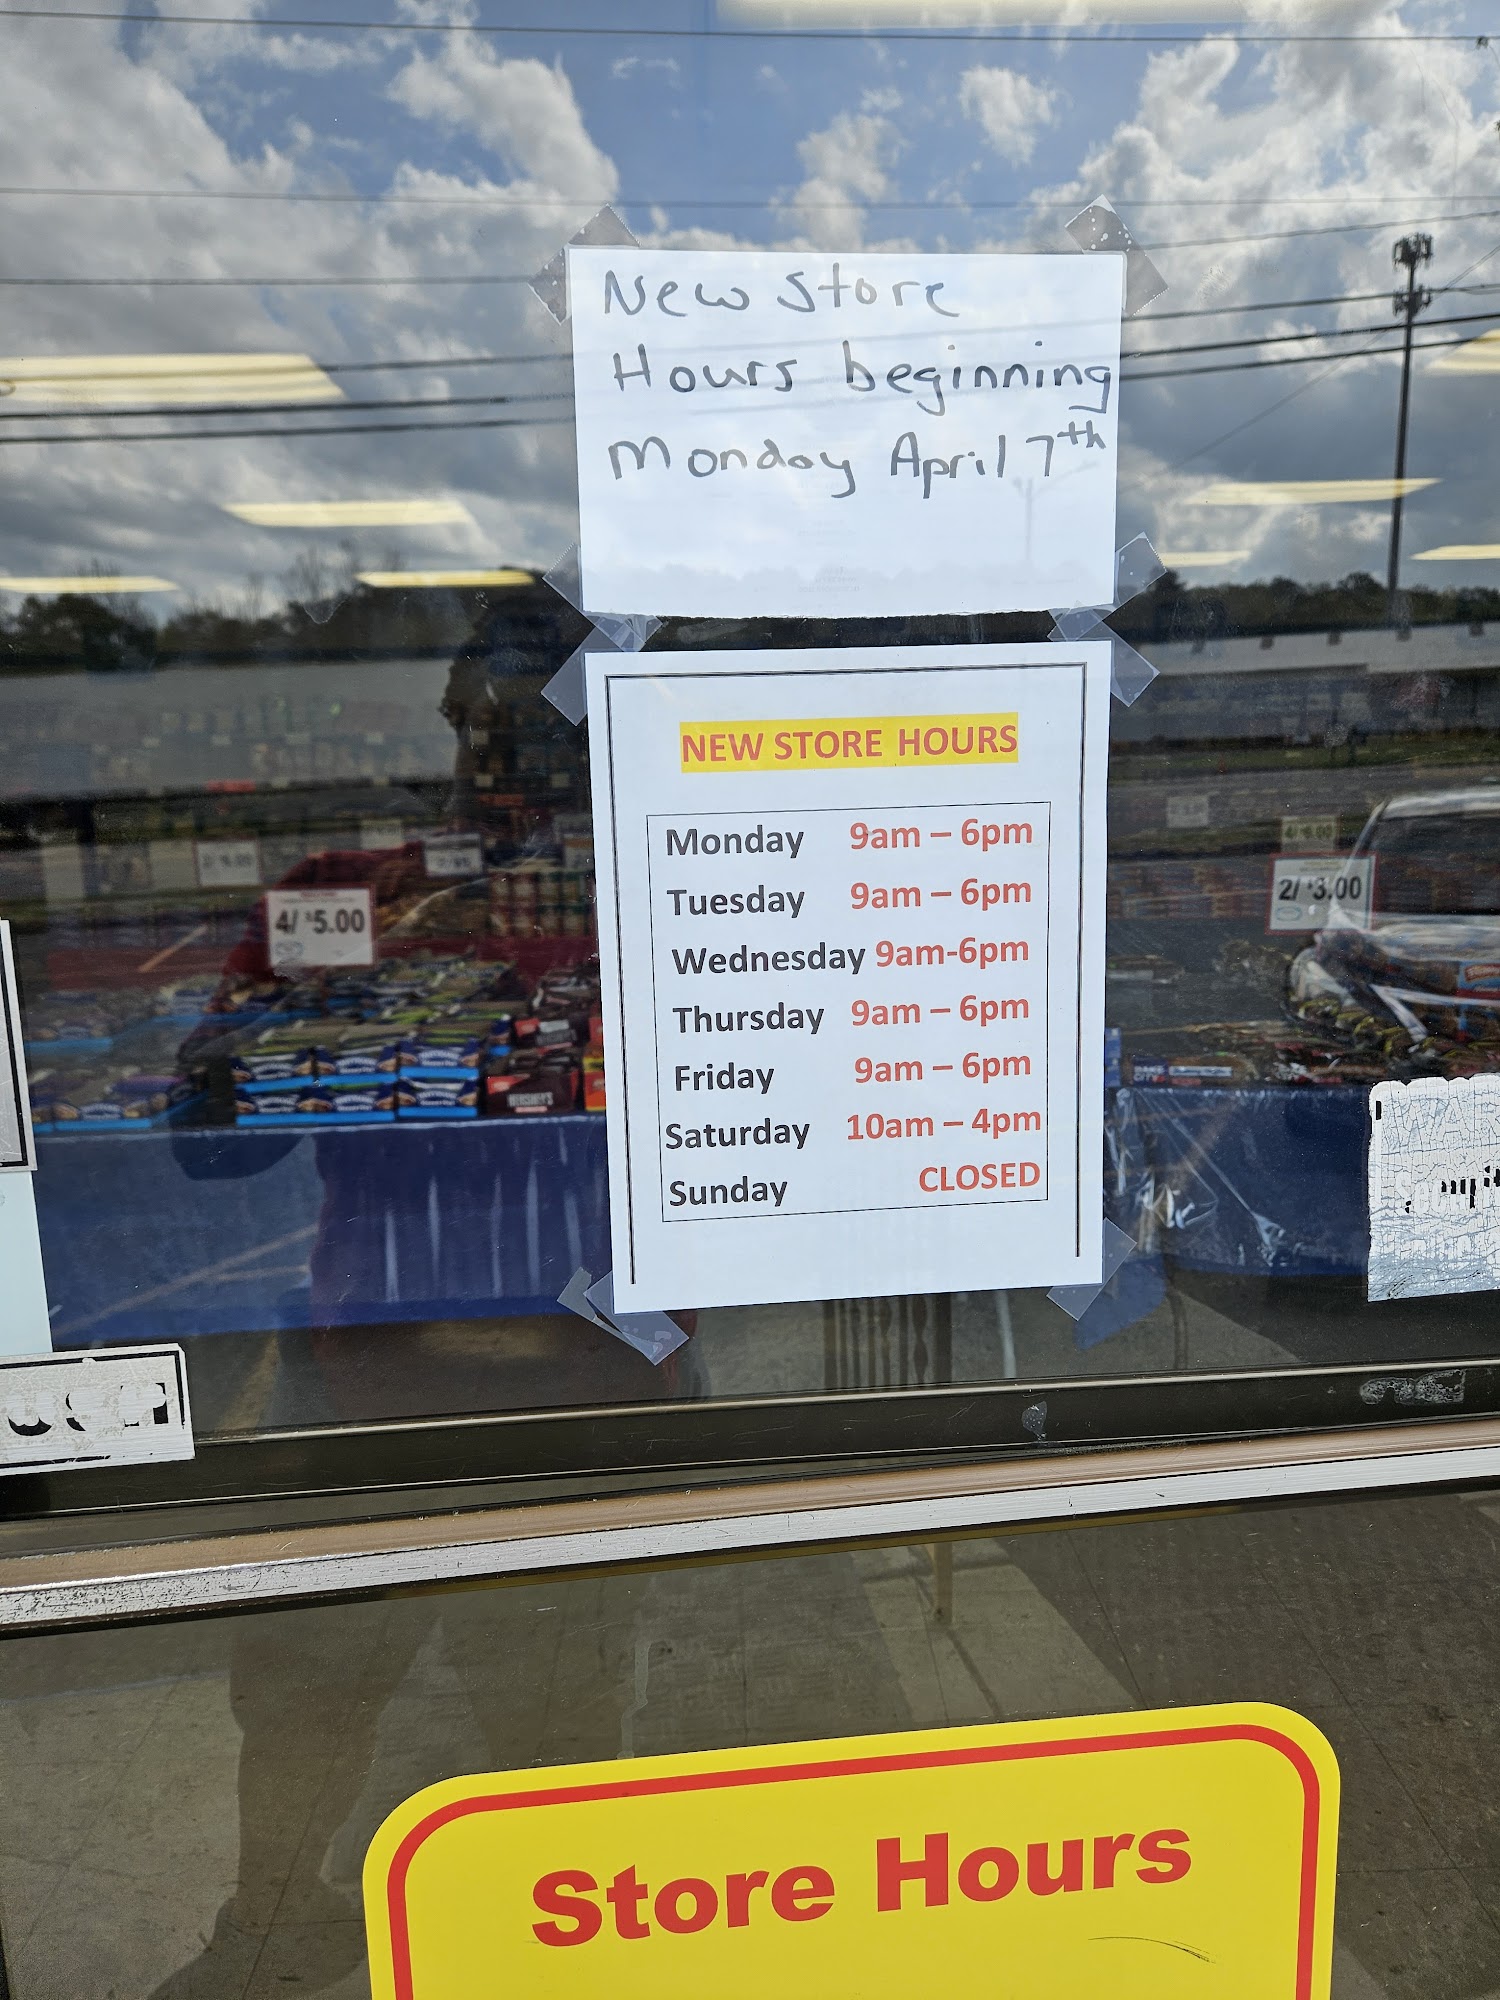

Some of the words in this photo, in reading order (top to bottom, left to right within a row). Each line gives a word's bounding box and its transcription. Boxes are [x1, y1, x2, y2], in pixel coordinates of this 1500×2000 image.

[604, 270, 750, 318] New
[777, 263, 960, 317] Store
[613, 343, 797, 393] Hours
[842, 340, 1111, 416] beginning
[608, 436, 856, 498] Monday
[891, 432, 1006, 499] April
[1026, 420, 1107, 477] 7th
[683, 734, 763, 761] NEW
[775, 729, 882, 759] STORE
[899, 725, 1017, 755] HOURS
[666, 824, 804, 859] Monday
[850, 822, 920, 850] 9am
[961, 818, 1033, 850] 6pm
[666, 884, 805, 919] Tuesday
[850, 882, 921, 909] 9am
[961, 878, 1031, 910] 6pm
[1278, 878, 1301, 901] 2/
[275, 908, 299, 935] 4/
[671, 941, 866, 975] Wednesday
[876, 938, 1030, 970] 9am-6pm
[672, 1001, 825, 1035] Thursday
[851, 999, 921, 1026] 9am
[960, 995, 1029, 1026] 6pm
[675, 1061, 775, 1095] Friday
[855, 1057, 924, 1083] 9am
[962, 1052, 1031, 1084] 6pm
[665, 1118, 811, 1150] Saturday
[847, 1113, 934, 1140] 10am
[971, 1108, 1041, 1139] 4pm
[669, 1175, 788, 1208] Sunday
[919, 1162, 1041, 1192] CLOSED
[532, 1864, 836, 1947] Store
[876, 1828, 1192, 1912] Hours
